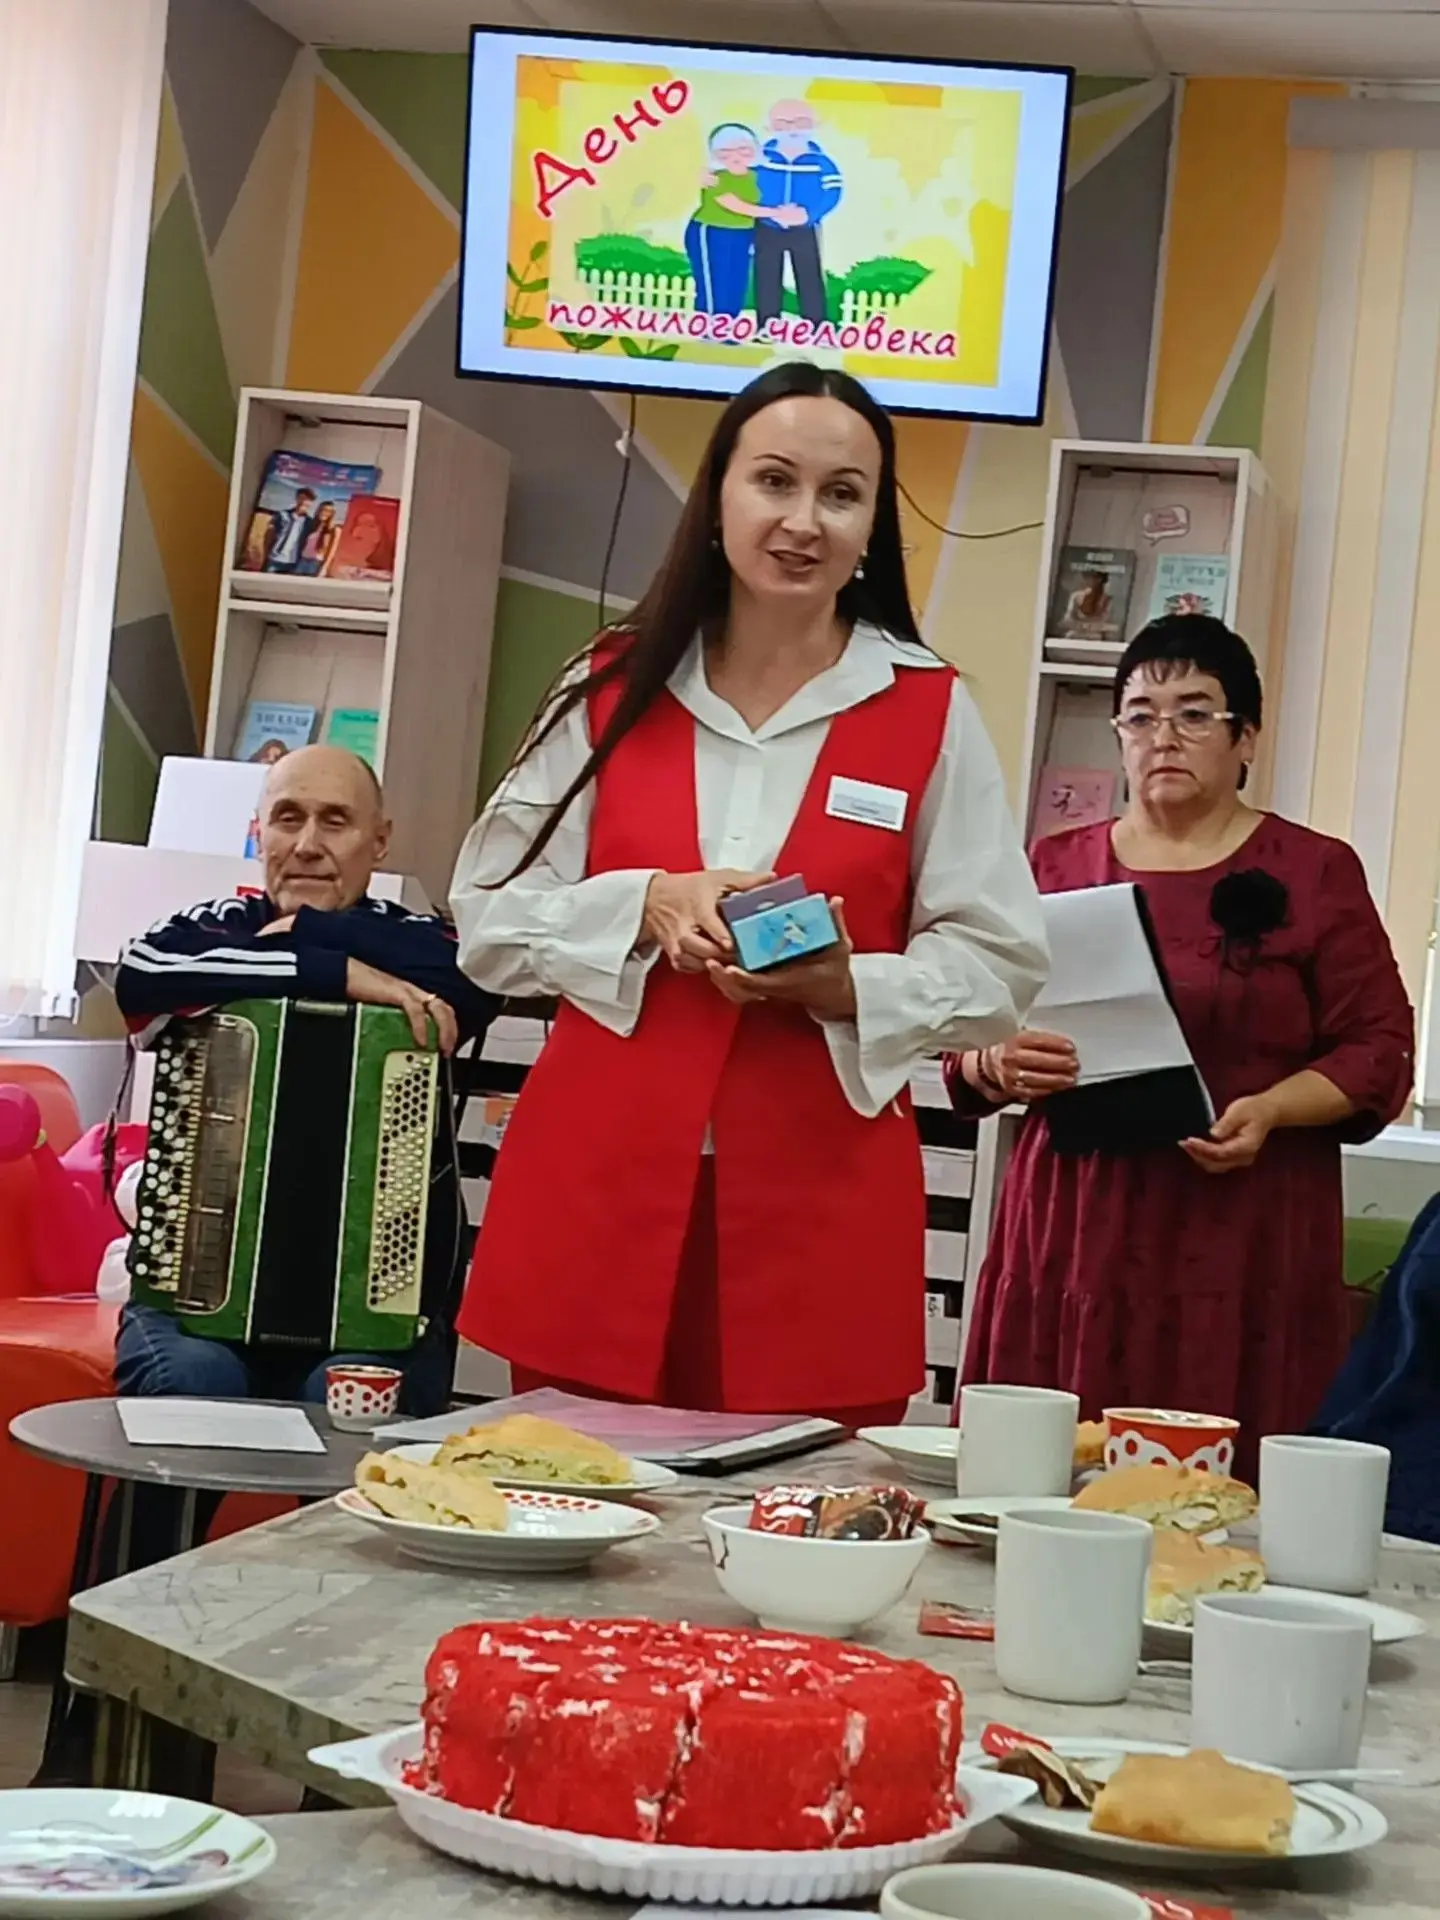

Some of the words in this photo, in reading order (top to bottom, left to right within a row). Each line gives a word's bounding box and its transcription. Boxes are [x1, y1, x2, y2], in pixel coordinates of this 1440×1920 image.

[534, 80, 688, 217] День
[549, 302, 751, 341] пожилого
[769, 316, 956, 357] человека
